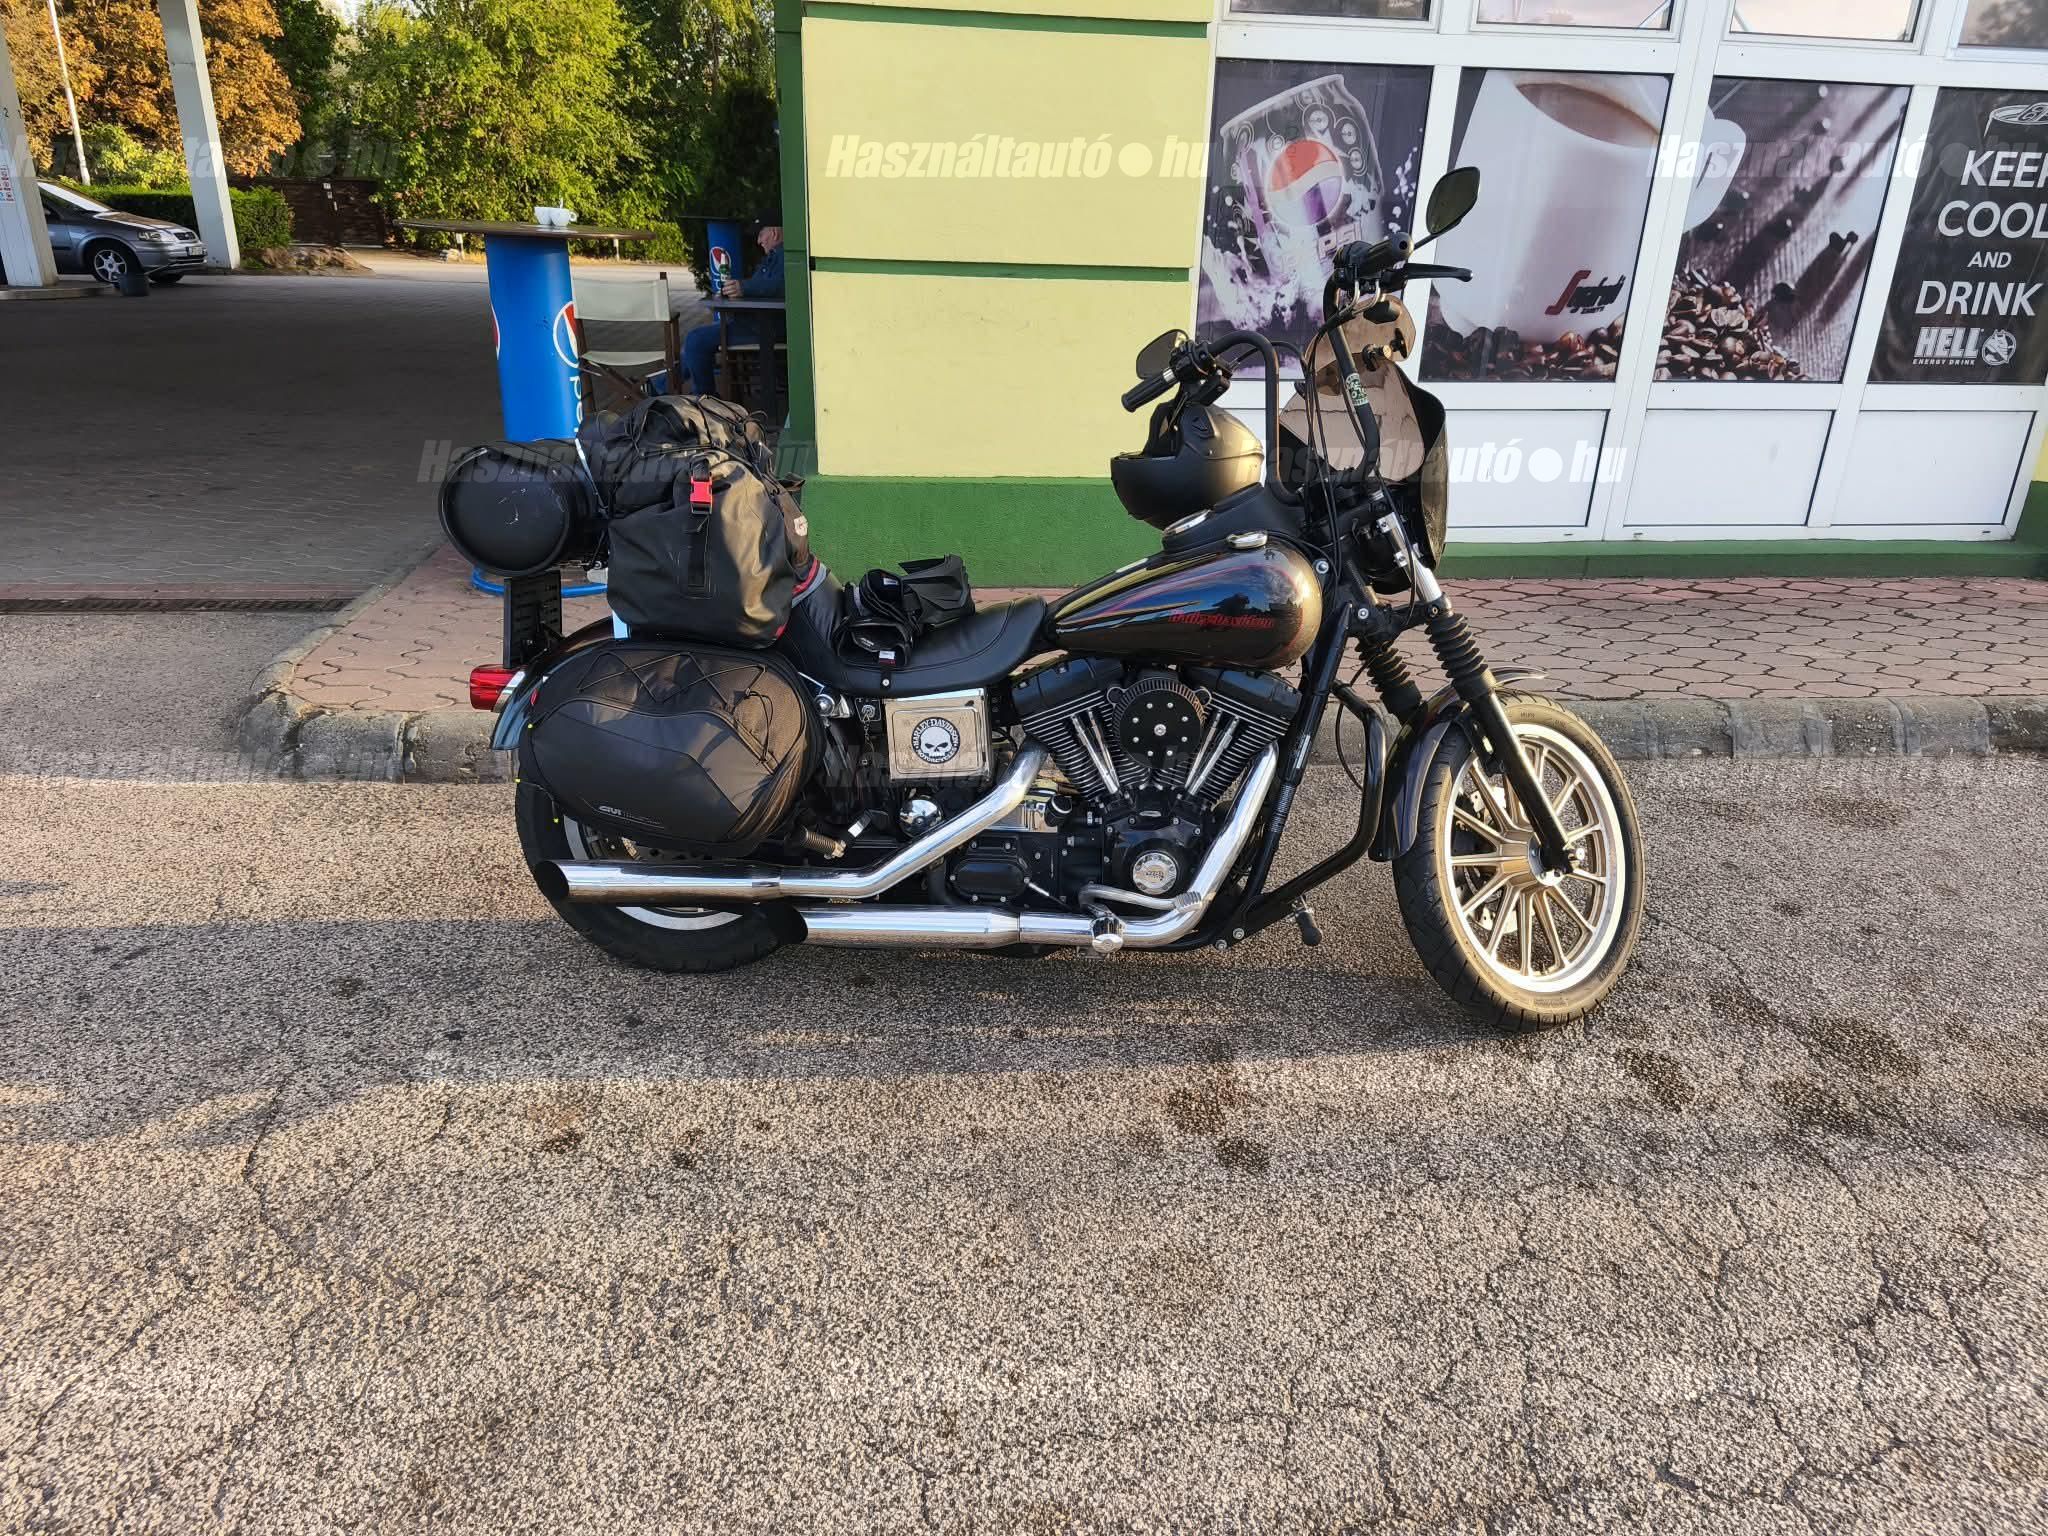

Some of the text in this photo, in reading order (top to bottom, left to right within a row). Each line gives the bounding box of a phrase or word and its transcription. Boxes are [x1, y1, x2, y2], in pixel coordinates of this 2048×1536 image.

[1937, 200, 2048, 239] COOL
[1967, 251, 2012, 269] AND
[1915, 280, 2044, 317] DRINK
[1913, 326, 1981, 359] HELL
[1912, 358, 1946, 366] ENERGY
